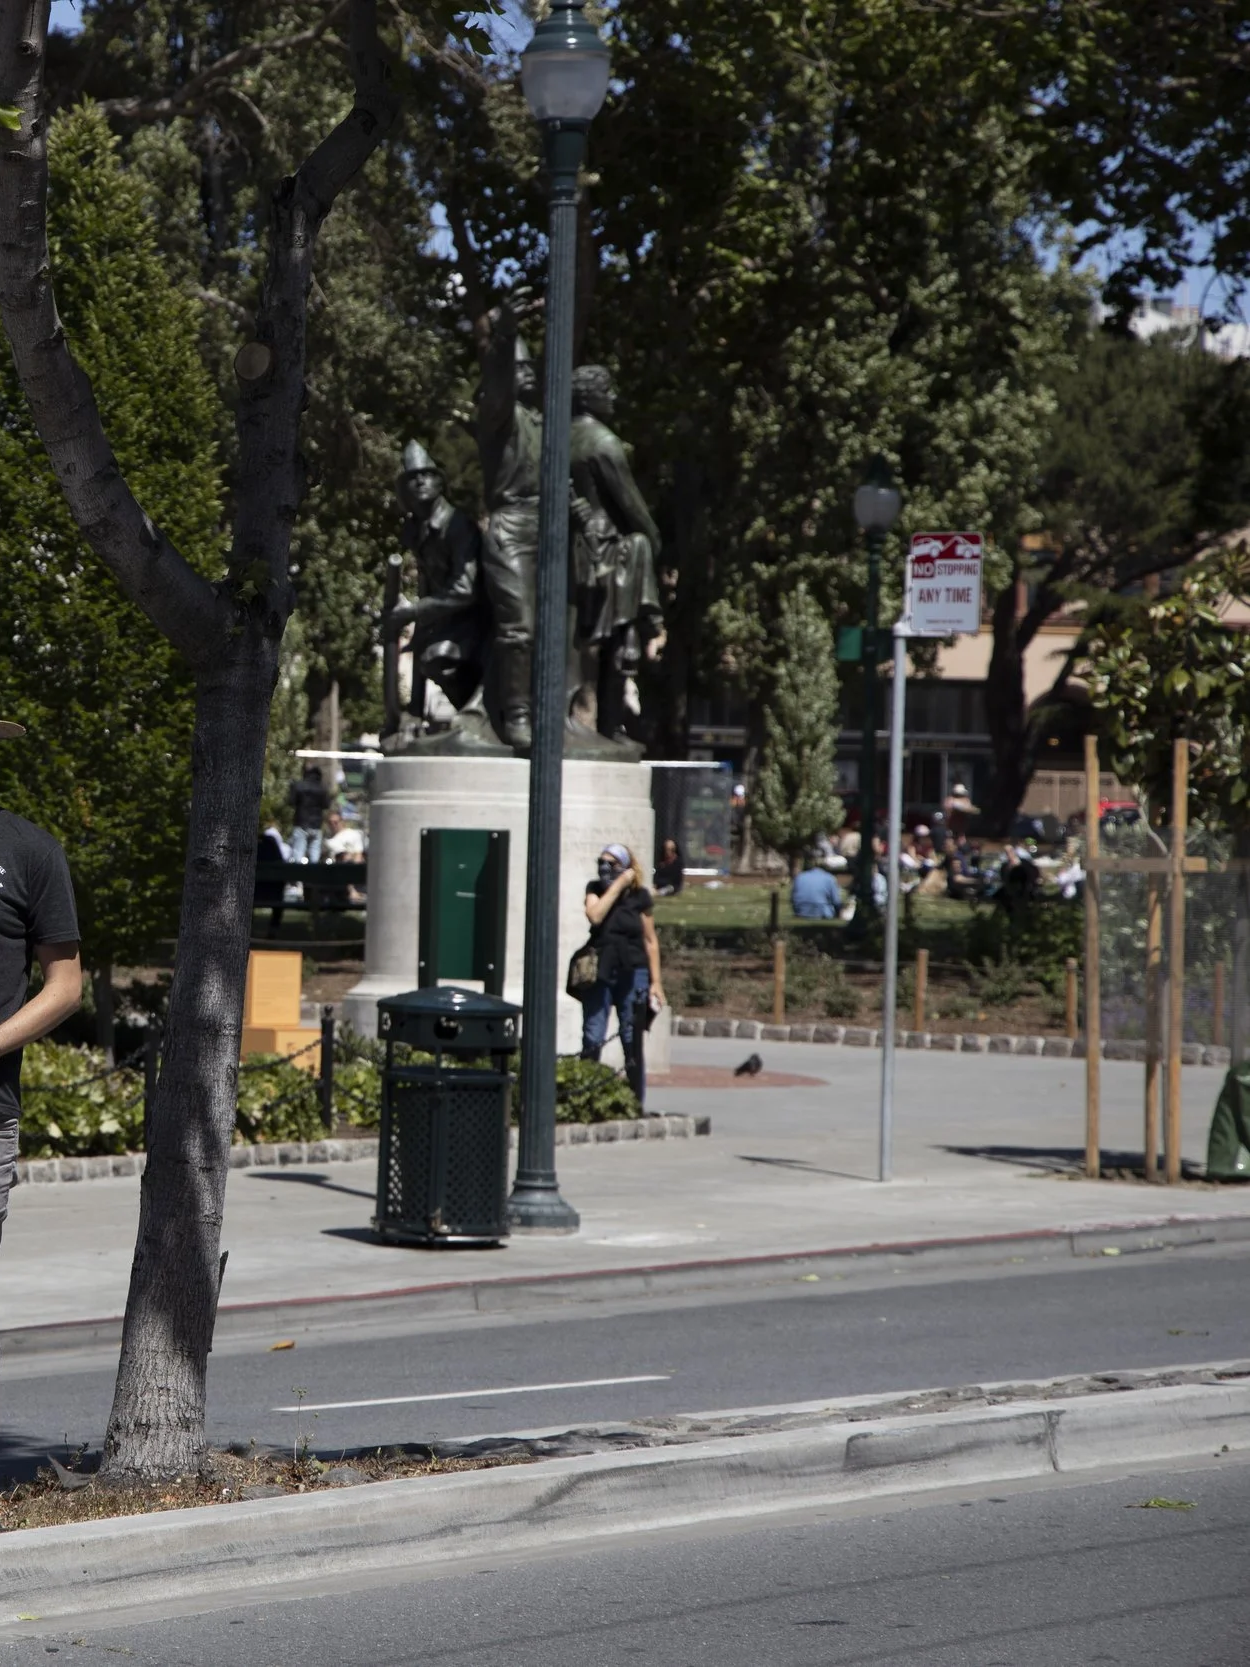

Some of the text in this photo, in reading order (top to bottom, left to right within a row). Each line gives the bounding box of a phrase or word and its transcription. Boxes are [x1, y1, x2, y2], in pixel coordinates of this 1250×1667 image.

[914, 562, 978, 577] NO STOPPING
[918, 586, 973, 604] ANY TIME
